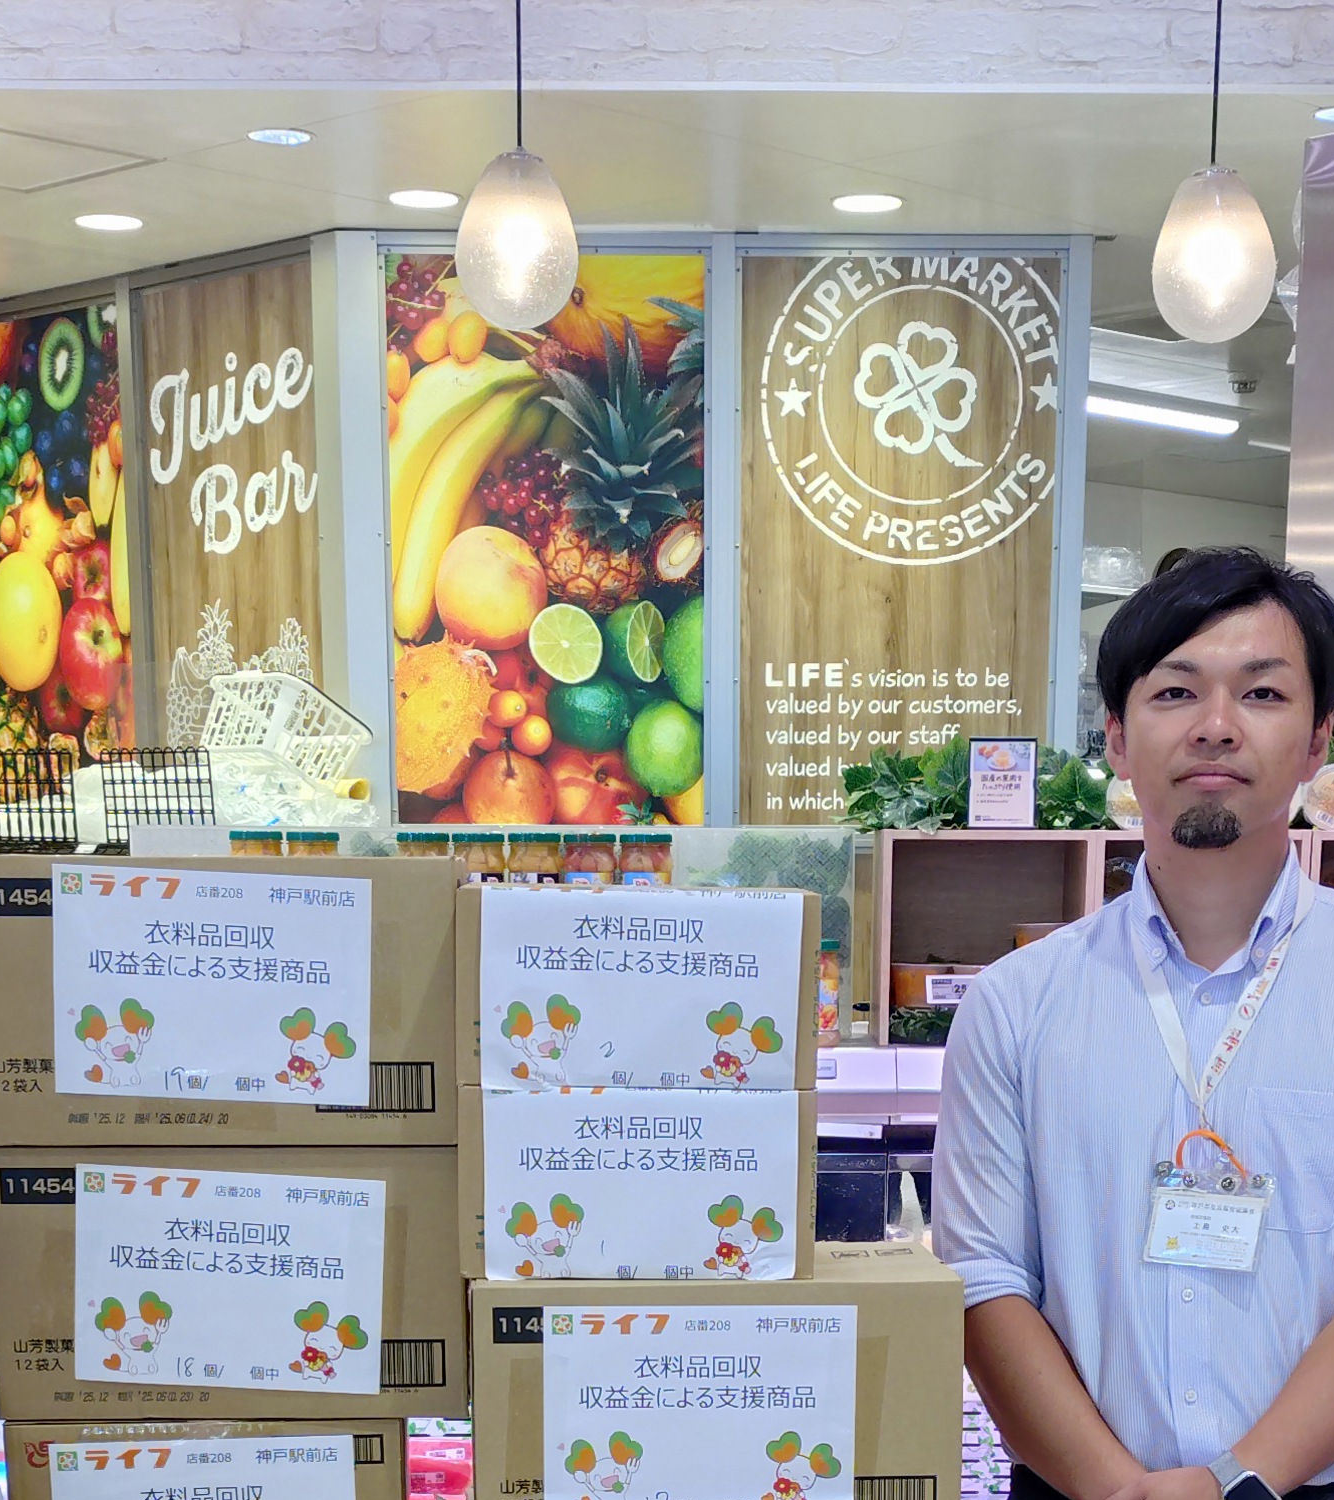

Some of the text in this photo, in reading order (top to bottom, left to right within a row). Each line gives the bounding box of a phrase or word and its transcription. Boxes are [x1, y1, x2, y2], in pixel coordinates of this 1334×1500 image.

[784, 256, 1060, 368] SUPER MARKET
[149, 346, 315, 486] Juice
[190, 450, 318, 554] Bar
[793, 451, 1047, 552] LIFE PRESENTS
[869, 668, 1010, 688] vision is to be
[766, 694, 1022, 724] valued by our customers,
[766, 725, 831, 746] valued
[837, 724, 865, 754] by
[868, 730, 902, 746] our
[766, 757, 831, 777] valued
[767, 790, 845, 810] in which
[89, 874, 356, 909] ライフ 店番208 神戸駅前店
[144, 921, 274, 951] 衣料品回収
[573, 915, 704, 944] 衣料品回収
[88, 949, 331, 985] 収益金による支援商品
[515, 945, 759, 979] 収益金による支援商品
[599, 1041, 616, 1058] 2
[235, 1076, 265, 1093] 個中
[660, 1071, 690, 1088] 個中
[574, 1115, 703, 1142] 衣料品回収
[519, 1147, 759, 1173] 収益金による支援商品
[5, 1176, 75, 1195] 11454
[111, 1173, 370, 1208] ライフ 店番208 神戸駅前店
[164, 1218, 291, 1249] 衣料品回収
[109, 1244, 345, 1281] 収益金による支援商品
[663, 1264, 694, 1280] 個中
[579, 1313, 842, 1335] ライフ 店番208 神戸駅前店
[13, 1337, 75, 1354] 山芳製菓
[14, 1357, 65, 1373] 12袋入
[176, 1356, 193, 1379] 18
[249, 1365, 280, 1381] 個中
[633, 1354, 762, 1380] 衣料品回収
[579, 1385, 817, 1411] 収益金による支援商品
[84, 1447, 338, 1471] ライフ 店番208 神戸駅前店
